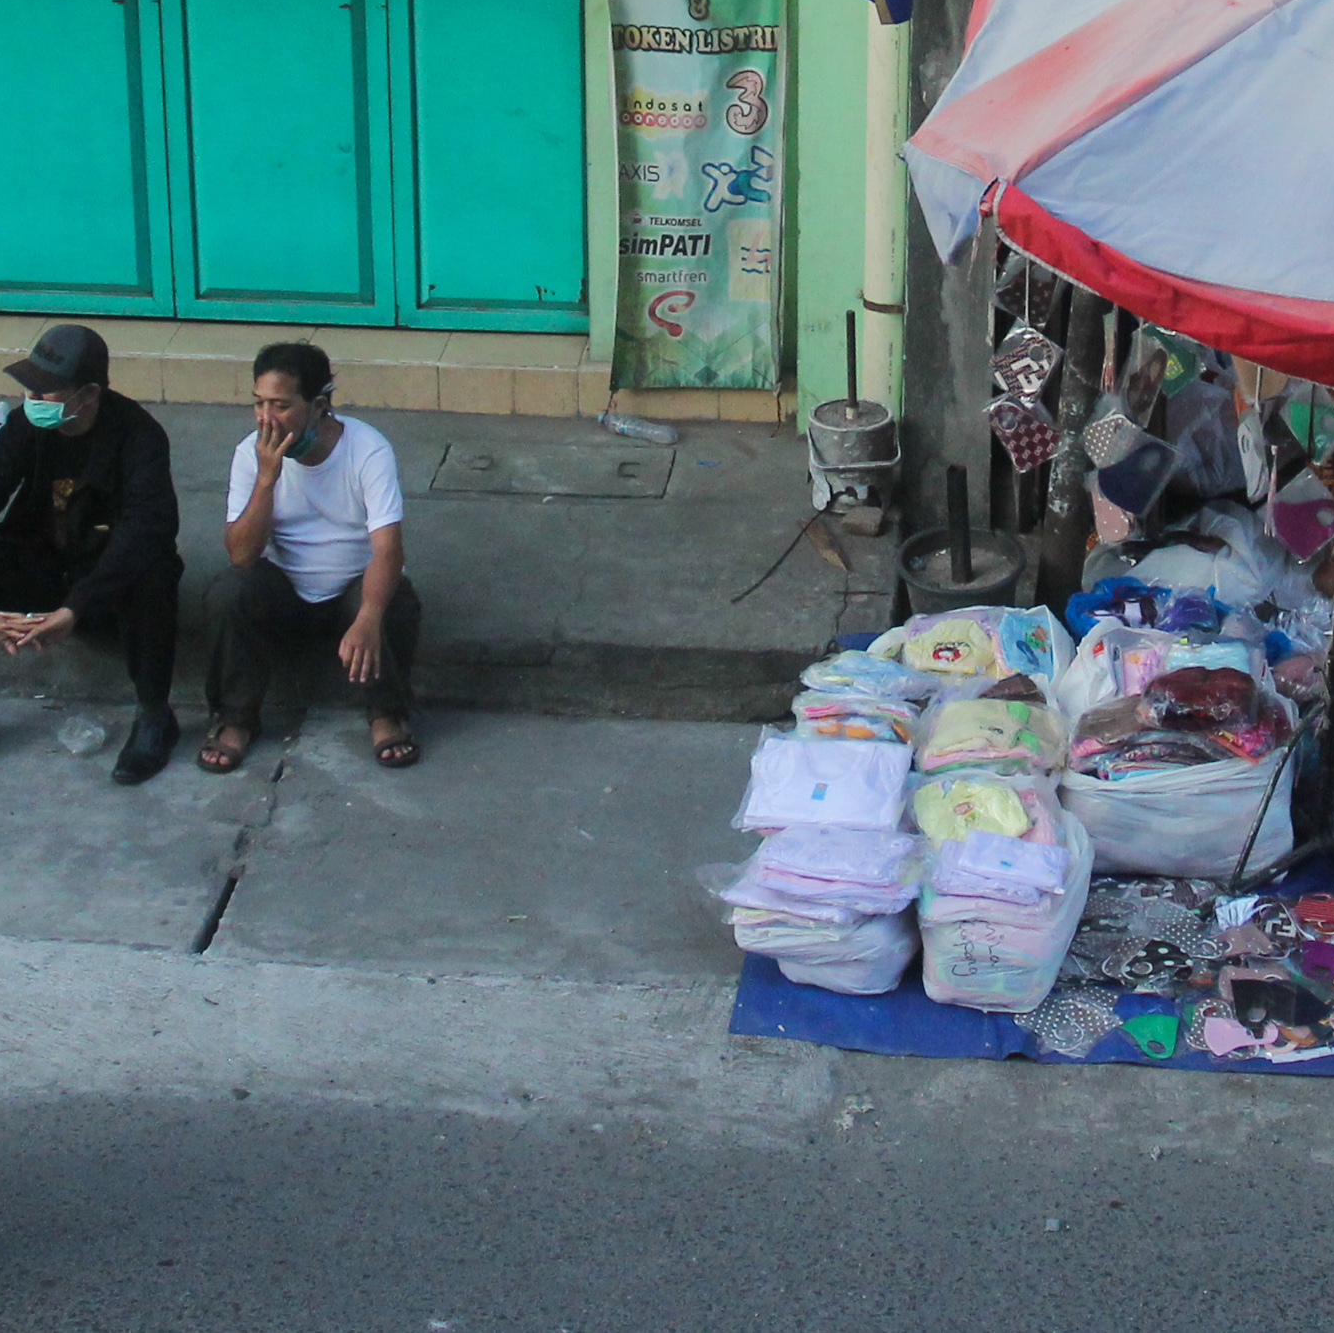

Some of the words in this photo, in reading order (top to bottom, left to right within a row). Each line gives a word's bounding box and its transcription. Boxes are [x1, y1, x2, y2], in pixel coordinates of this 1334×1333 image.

[612, 23, 693, 55] TOKEN
[725, 69, 769, 136] 3
[619, 164, 661, 183] AXIS
[649, 216, 703, 228] TELKOMSEL
[619, 232, 711, 257] simPATI
[636, 268, 708, 284] smartfren
